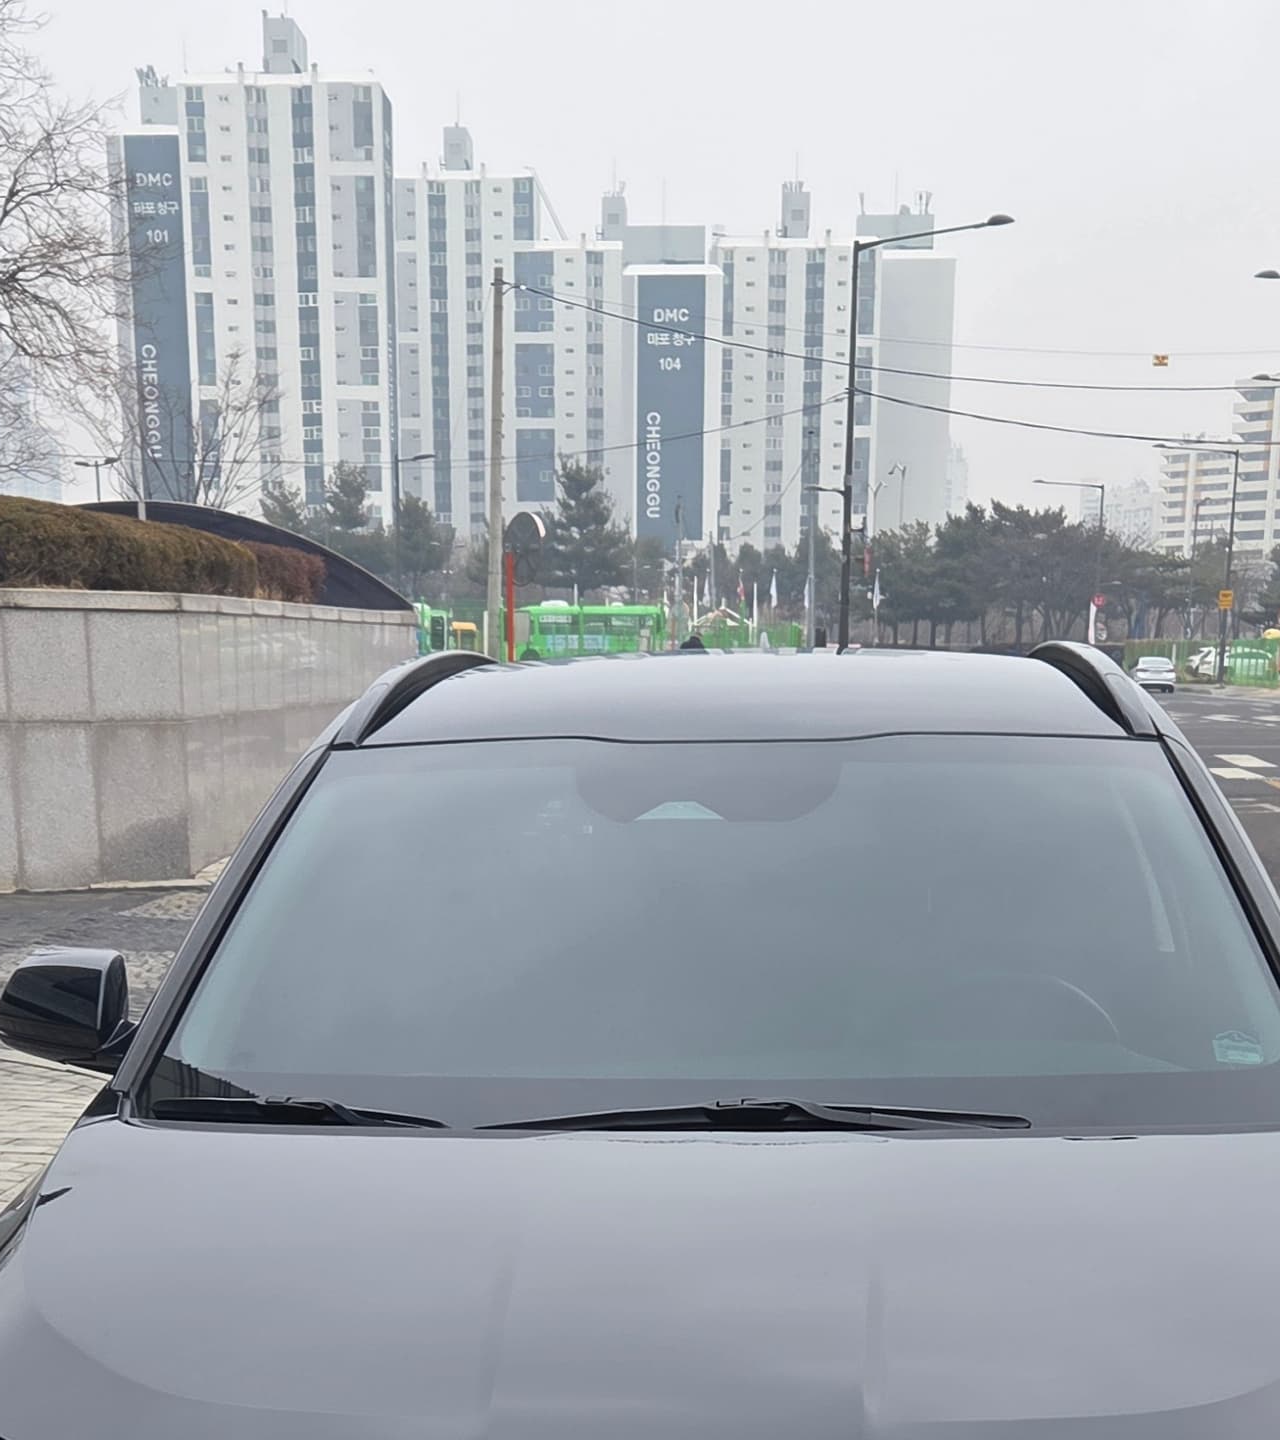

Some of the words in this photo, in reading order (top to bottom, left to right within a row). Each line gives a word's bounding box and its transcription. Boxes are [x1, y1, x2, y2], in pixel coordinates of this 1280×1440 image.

[135, 172, 173, 187] DMC
[146, 229, 169, 243] 101
[653, 308, 689, 322] DMC
[659, 357, 682, 371] 104
[141, 343, 163, 459] CHEONGGU
[646, 411, 661, 519] CHEONGGU
